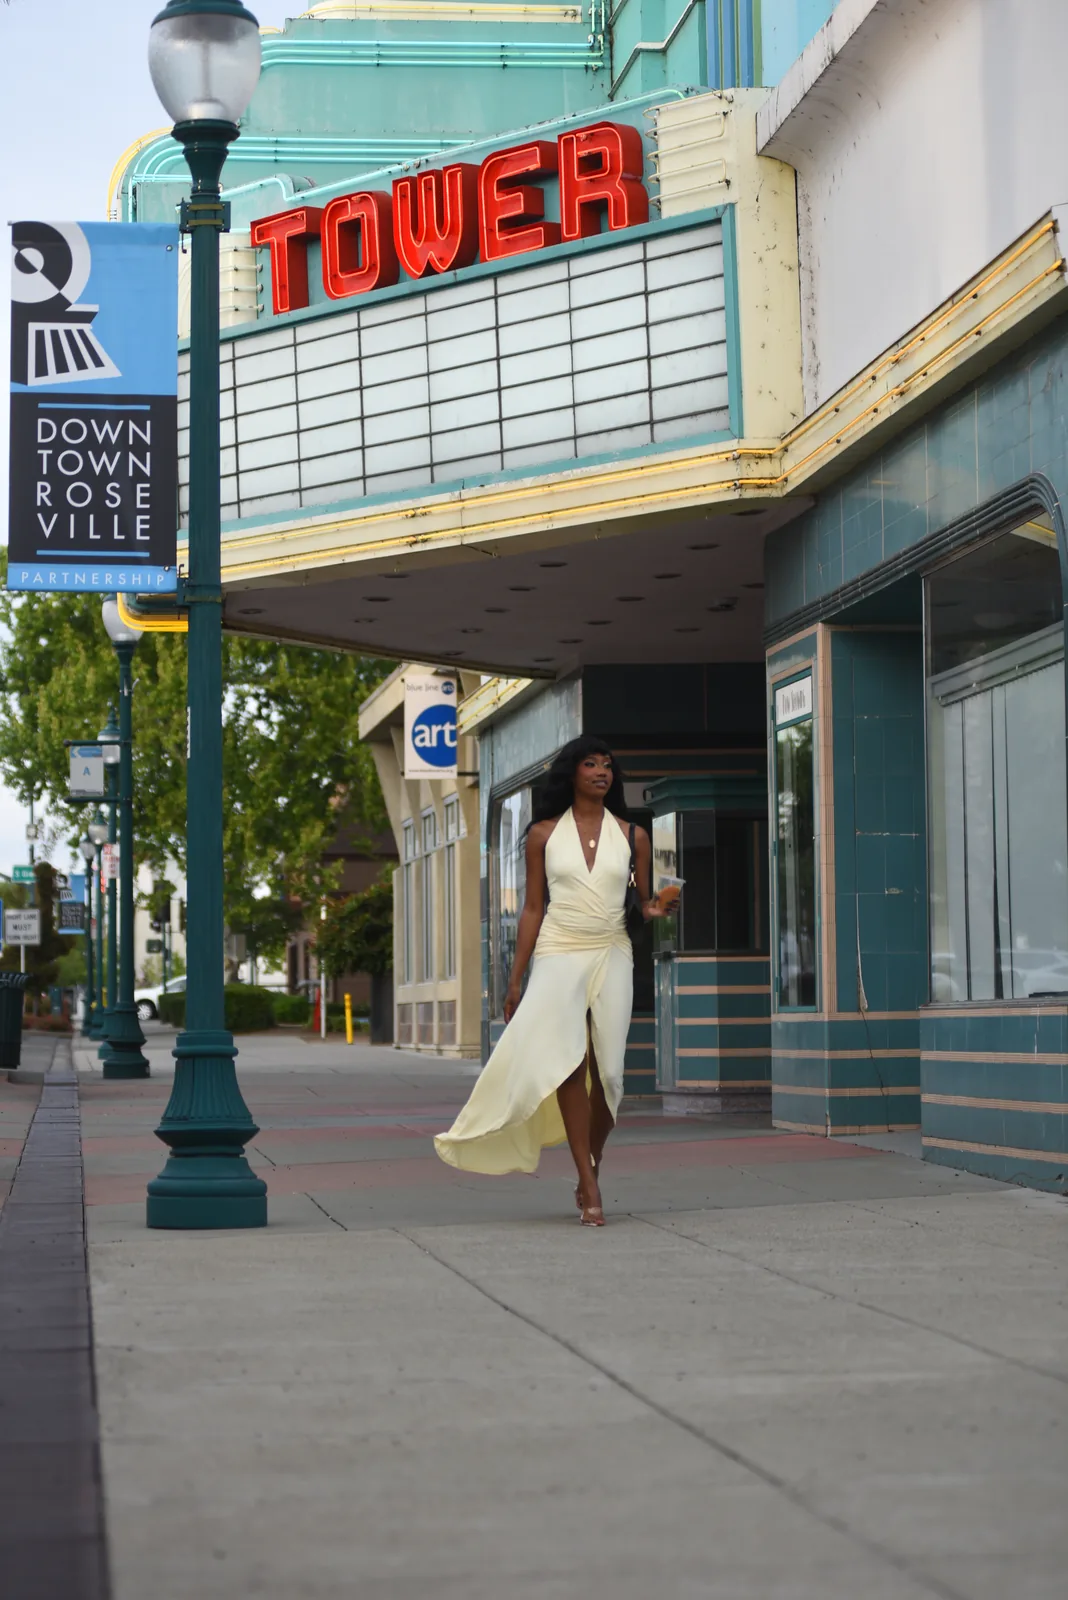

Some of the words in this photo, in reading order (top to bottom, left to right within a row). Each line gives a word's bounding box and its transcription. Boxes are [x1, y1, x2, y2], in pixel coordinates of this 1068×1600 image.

[250, 121, 650, 315] TOWER
[37, 418, 151, 446] DOWN
[37, 449, 151, 477] TOWN
[36, 480, 151, 509] ROSE
[36, 512, 151, 541] VILLE
[20, 570, 165, 587] PARTNERSHIP
[82, 765, 91, 777] A
